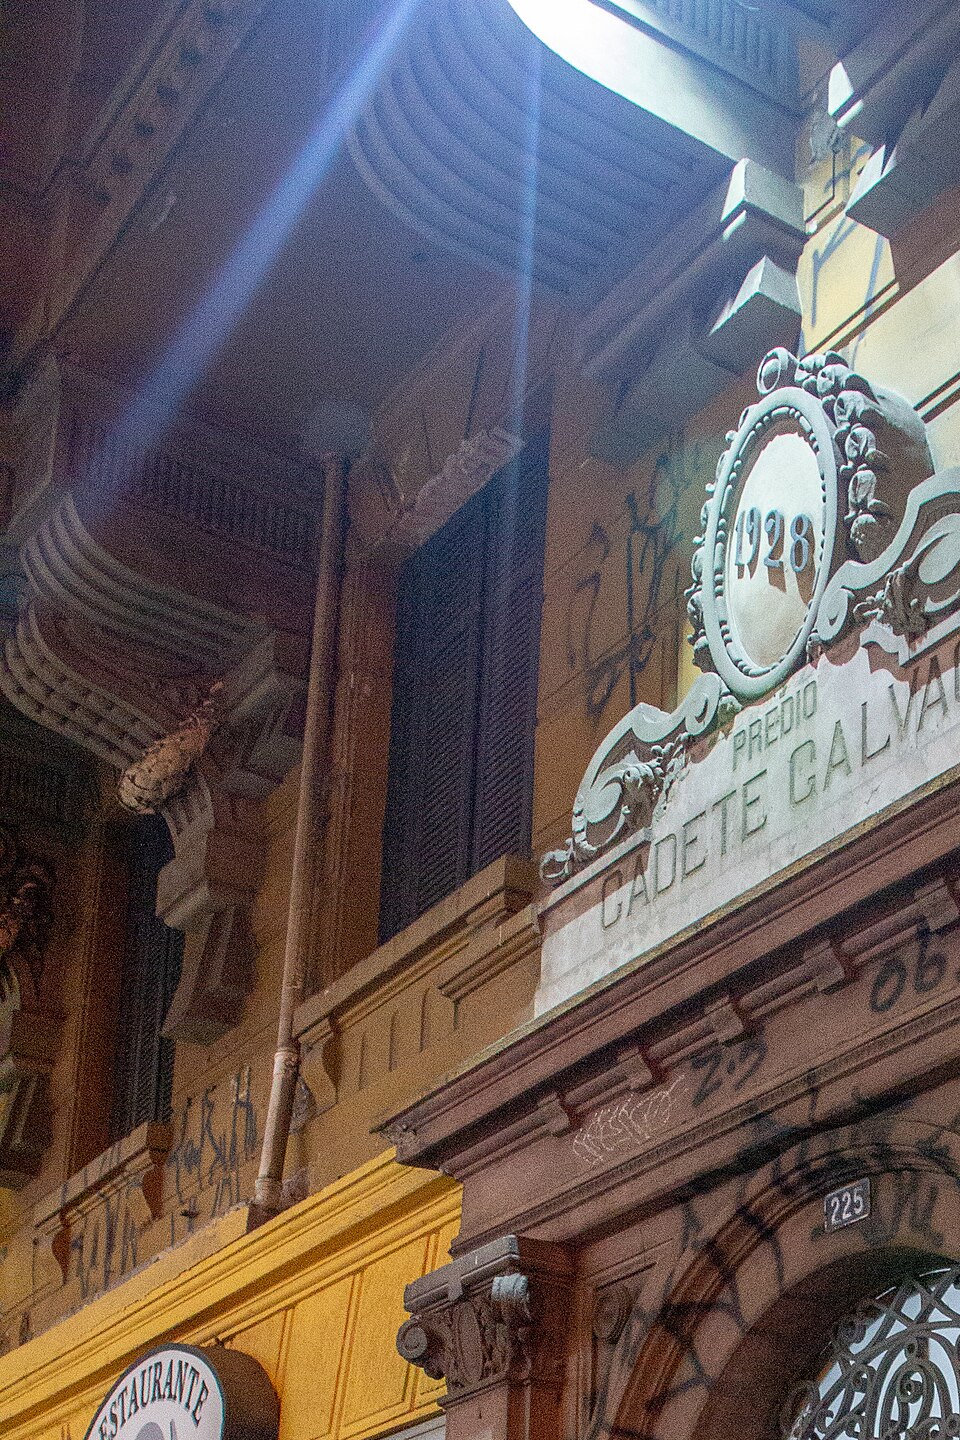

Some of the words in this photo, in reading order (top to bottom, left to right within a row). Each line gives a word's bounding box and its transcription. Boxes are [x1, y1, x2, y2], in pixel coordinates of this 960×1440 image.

[734, 507, 810, 573] 1928
[601, 768, 768, 931] CADETE
[831, 1186, 864, 1225] 225
